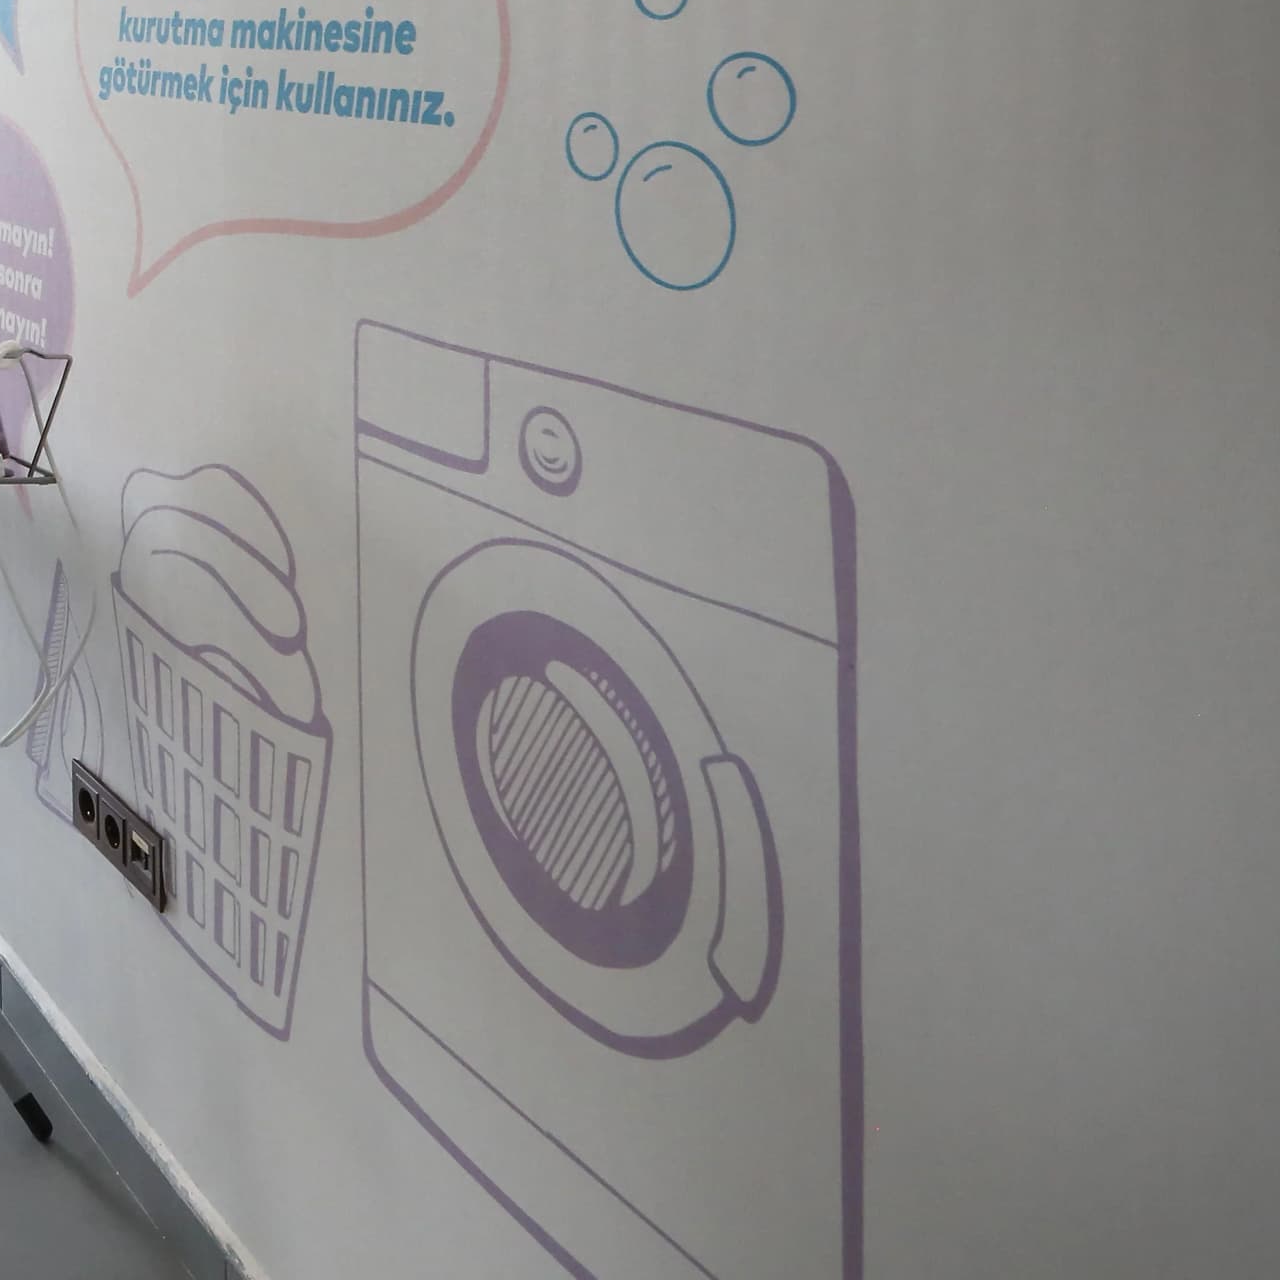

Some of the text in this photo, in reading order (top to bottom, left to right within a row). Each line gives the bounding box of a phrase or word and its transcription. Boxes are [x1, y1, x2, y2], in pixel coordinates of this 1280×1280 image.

[118, 5, 418, 56] kurutma makinesine
[98, 56, 457, 128] götürmek için kullanınız.
